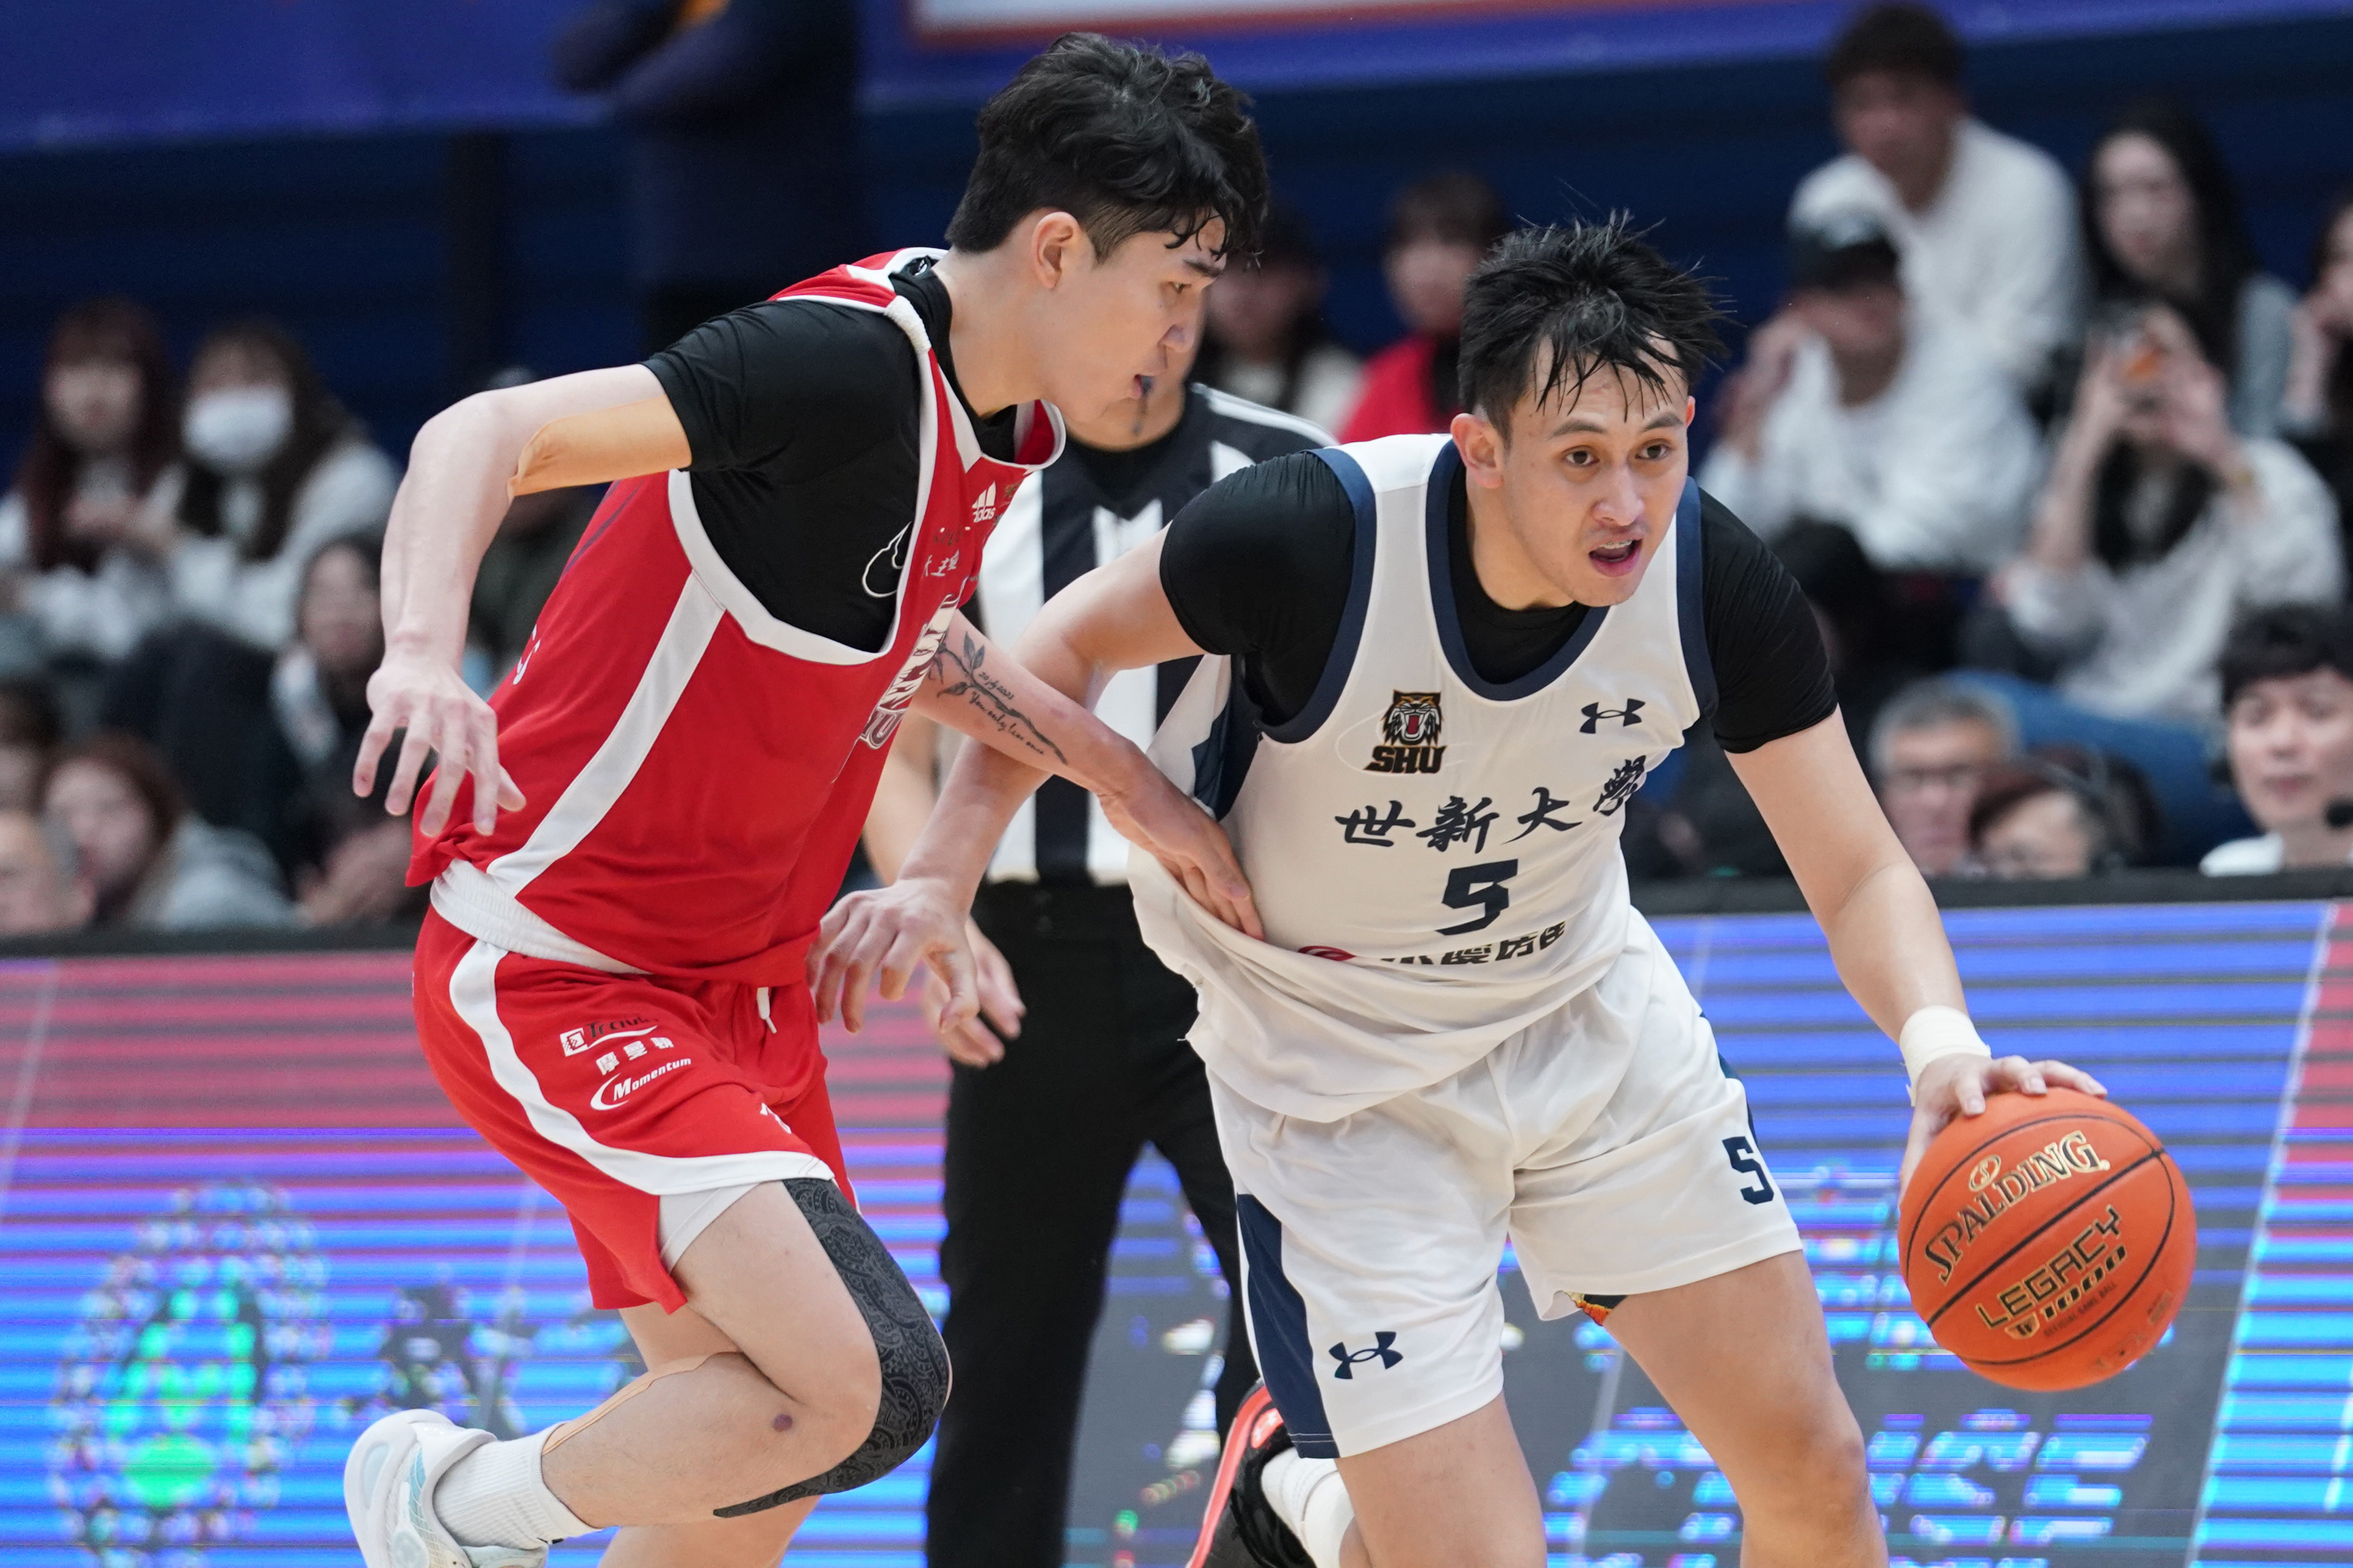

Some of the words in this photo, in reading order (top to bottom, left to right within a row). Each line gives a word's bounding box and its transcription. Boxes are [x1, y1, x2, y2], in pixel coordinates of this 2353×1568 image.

[1363, 745, 1448, 774] SHU
[1334, 755, 1647, 854] 世新大學
[1436, 859, 1518, 936] 5
[613, 1058, 691, 1101] Momentum
[1722, 1136, 1774, 1205] 5
[1924, 1129, 2106, 1287] SPALDING
[1975, 1204, 2123, 1330] LEGACY
